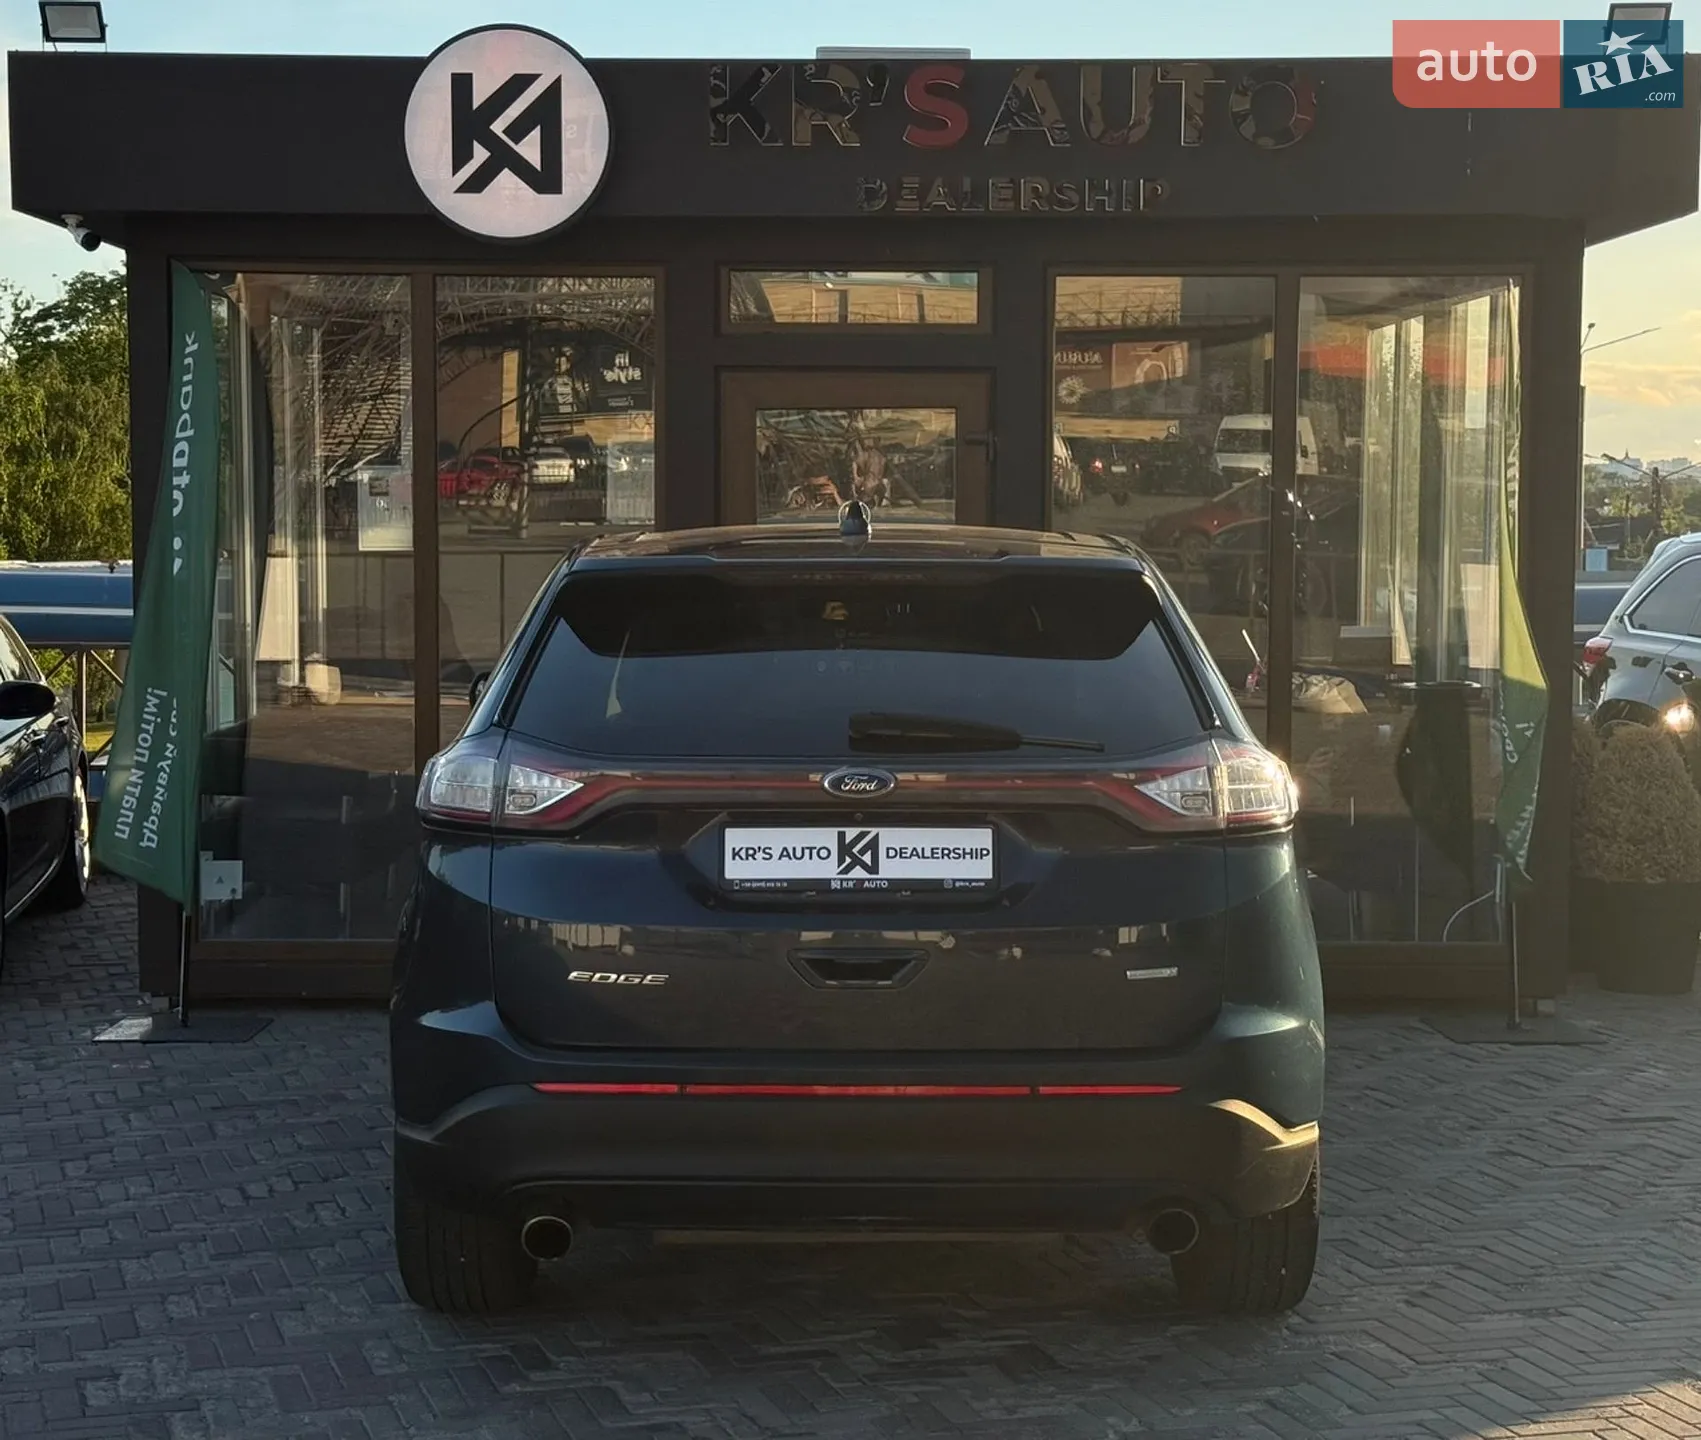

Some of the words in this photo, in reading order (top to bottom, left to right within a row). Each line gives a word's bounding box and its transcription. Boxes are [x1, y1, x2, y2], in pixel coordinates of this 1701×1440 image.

[984, 62, 1318, 150] AUTO
[857, 176, 1171, 213] DEALERSHIP
[840, 774, 879, 792] Ford
[731, 846, 773, 861] KR'S
[777, 846, 832, 861] AUTO
[885, 847, 991, 861] DEALERSHIP
[863, 879, 889, 889] AUTO
[567, 970, 670, 985] EDGE
